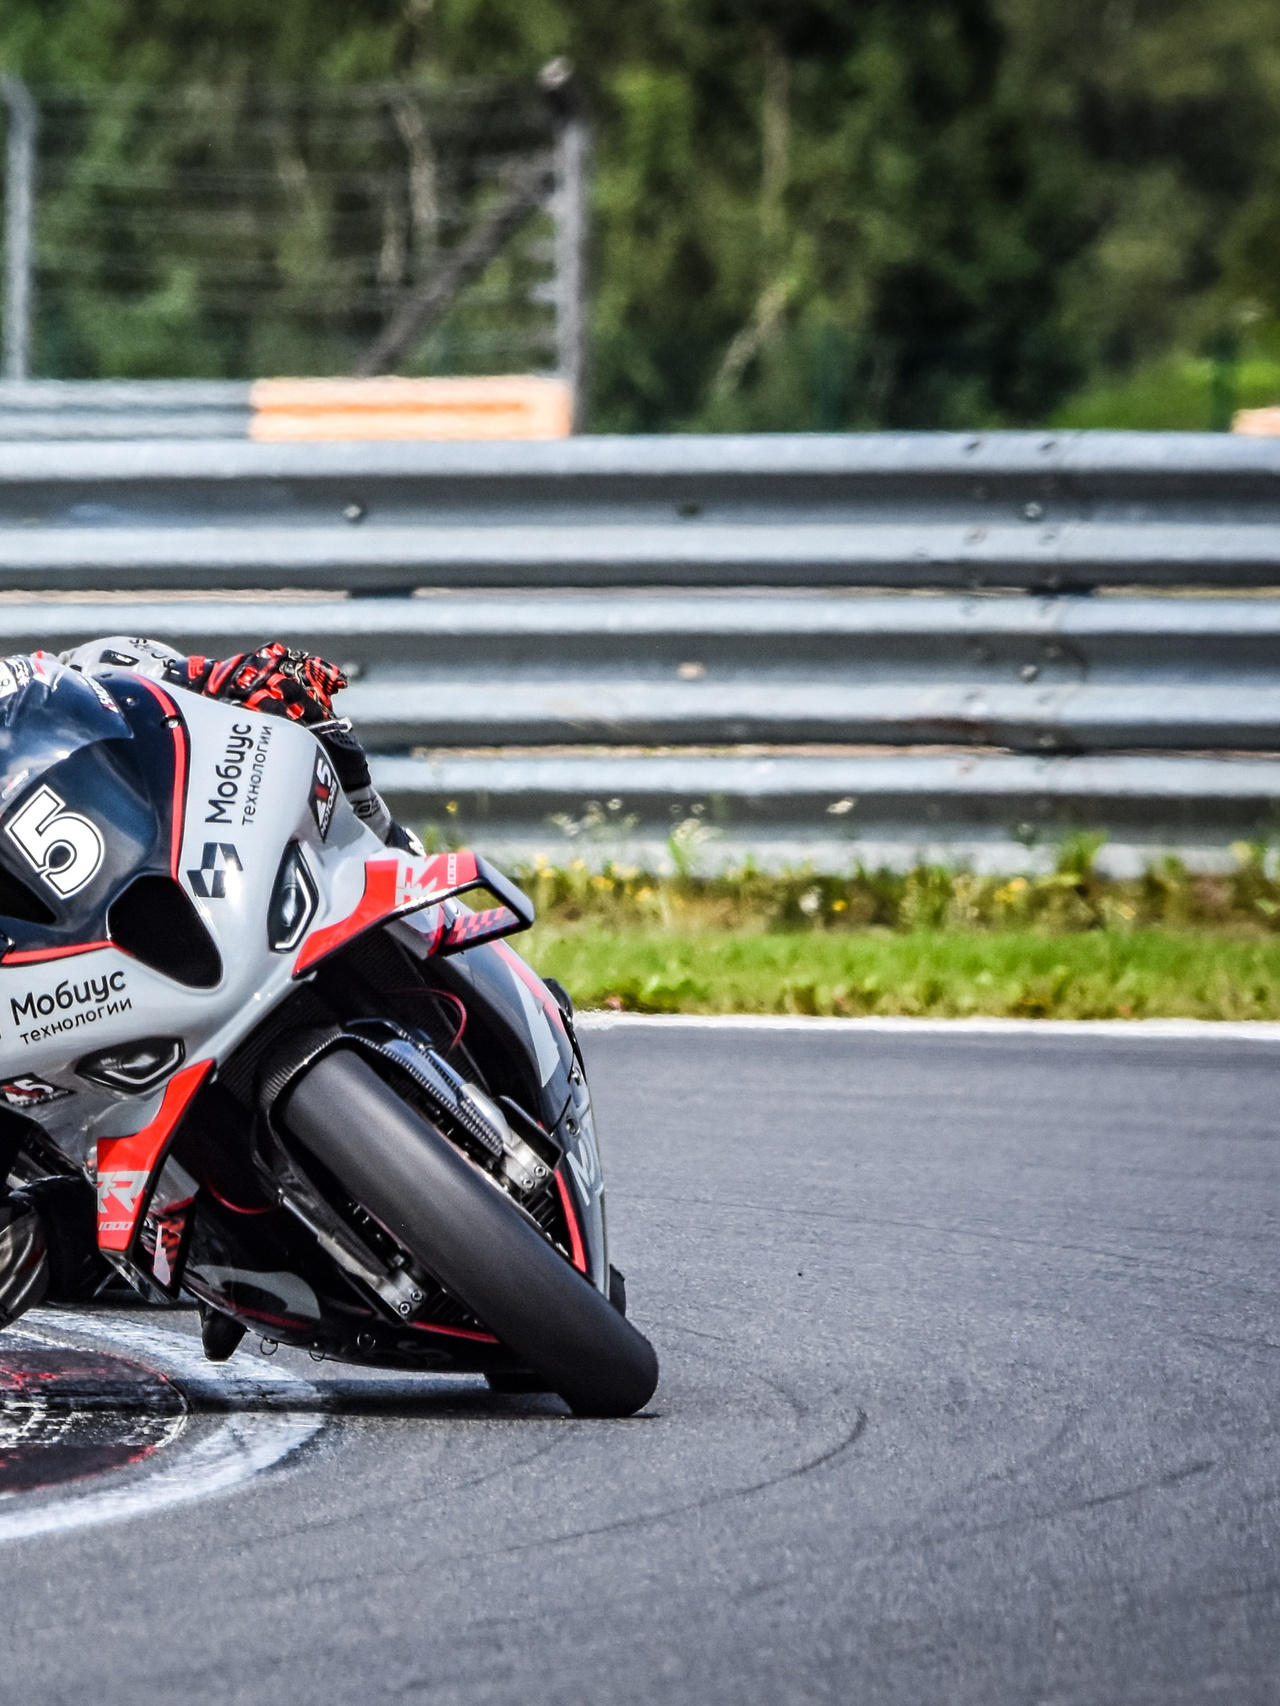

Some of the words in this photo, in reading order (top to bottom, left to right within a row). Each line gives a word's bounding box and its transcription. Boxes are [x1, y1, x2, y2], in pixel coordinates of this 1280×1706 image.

[204, 722, 253, 825] Мобиус
[241, 724, 273, 827] технологии
[4, 783, 105, 900] 5
[10, 970, 126, 1026] Мобиус
[19, 997, 133, 1045] технологии
